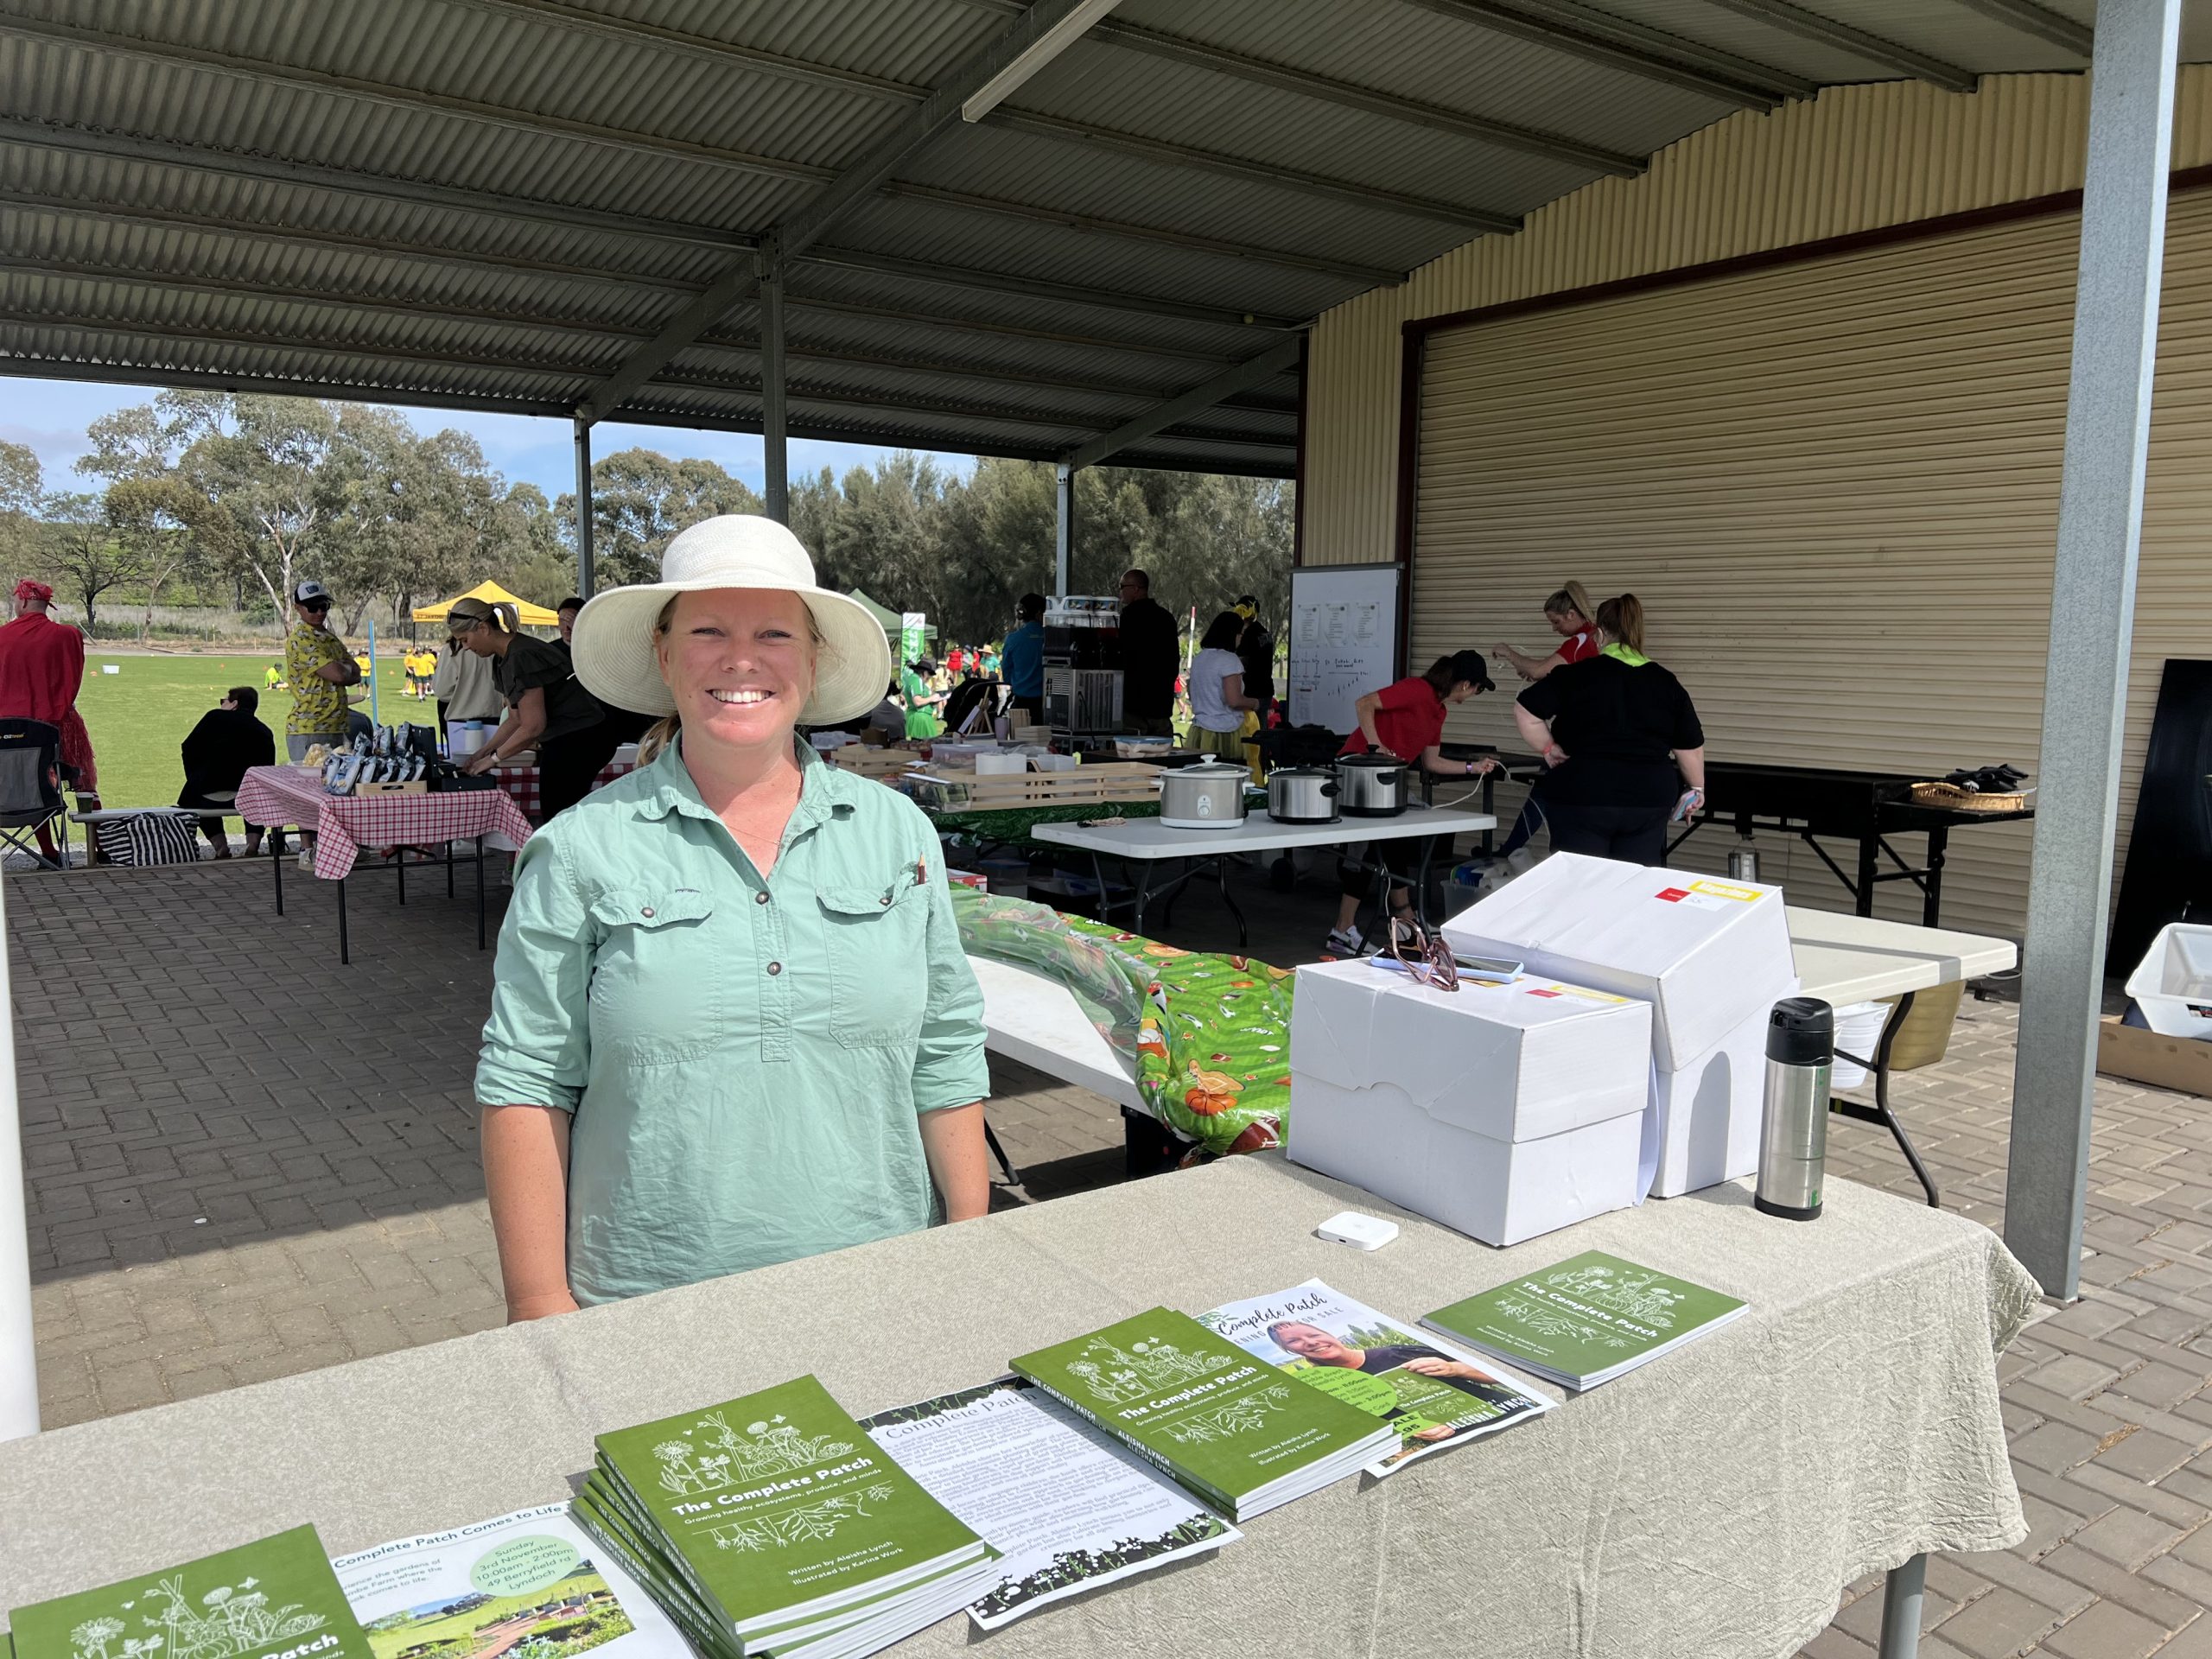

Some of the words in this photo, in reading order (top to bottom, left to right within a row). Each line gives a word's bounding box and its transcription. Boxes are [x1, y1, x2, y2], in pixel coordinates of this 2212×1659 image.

[1217, 1307, 1285, 1336] Complete
[1284, 1292, 1327, 1314] Patch
[1317, 1306, 1344, 1319] SALE
[1522, 1281, 1546, 1294] The
[1548, 1293, 1613, 1321] Complete
[1615, 1319, 1658, 1338] Patch
[1118, 1406, 1150, 1420] The
[1149, 1382, 1217, 1409] Complete
[1214, 1365, 1257, 1385] Patch
[886, 1408, 981, 1440] Complete
[981, 1392, 1037, 1412] Patch
[1030, 1376, 1042, 1388] THE
[1043, 1383, 1075, 1409] COMPLETE
[1076, 1403, 1096, 1421] PATCH
[1117, 1430, 1147, 1452] ALEISHA
[1147, 1447, 1170, 1467] LYNCH
[1446, 1410, 1497, 1431] ALEISHA
[1491, 1395, 1532, 1414] LYNCH
[1127, 1443, 1153, 1465] ALEISHA
[1155, 1460, 1176, 1480] LYNCH
[671, 1500, 712, 1516] The
[717, 1476, 813, 1505] Complete
[816, 1457, 874, 1480] Patch
[684, 1512, 721, 1525] Growing
[722, 1504, 753, 1516] healthy
[755, 1492, 804, 1509] ecosystems,
[806, 1482, 841, 1496] produce,
[842, 1476, 857, 1484] and
[859, 1469, 881, 1479] minds
[334, 1542, 410, 1567] Complete
[416, 1533, 458, 1546] Patch
[462, 1517, 512, 1535] Comes
[536, 1506, 562, 1516] Life
[615, 1502, 642, 1534] COMPLETE
[642, 1530, 660, 1551] PATCH
[616, 1482, 639, 1516] COMPLETE
[638, 1510, 652, 1533] PATCH
[664, 1546, 684, 1574] ALEISHA
[685, 1573, 702, 1596] LYNCH
[393, 1562, 429, 1574] gardens
[476, 1562, 524, 1581] 10:00am
[532, 1548, 574, 1562] 2:00pm
[480, 1561, 499, 1572] 3rd
[501, 1543, 557, 1564] November
[495, 1541, 535, 1557] Sunday
[598, 1503, 607, 1517] THE
[608, 1513, 634, 1547] COMPLETE
[634, 1541, 652, 1564] PATCH
[668, 1577, 691, 1606] ALEISHA
[692, 1601, 712, 1627] LYNCH
[787, 1564, 823, 1576] Written
[836, 1549, 868, 1562] Aleisha
[868, 1541, 893, 1552] Lynch
[793, 1568, 838, 1585] Illustrated
[852, 1555, 880, 1567] Karina
[880, 1548, 904, 1558] Work
[372, 1577, 395, 1587] Farm
[397, 1570, 425, 1580] where
[487, 1579, 501, 1587] 49
[504, 1560, 556, 1582] Berryfield
[508, 1569, 556, 1590] Lyndoch
[593, 1520, 602, 1535] THE
[603, 1530, 632, 1563] COMPLETE
[632, 1558, 650, 1580] PATCH
[668, 1594, 693, 1624] ALEISHA
[694, 1618, 714, 1643] LYNCH
